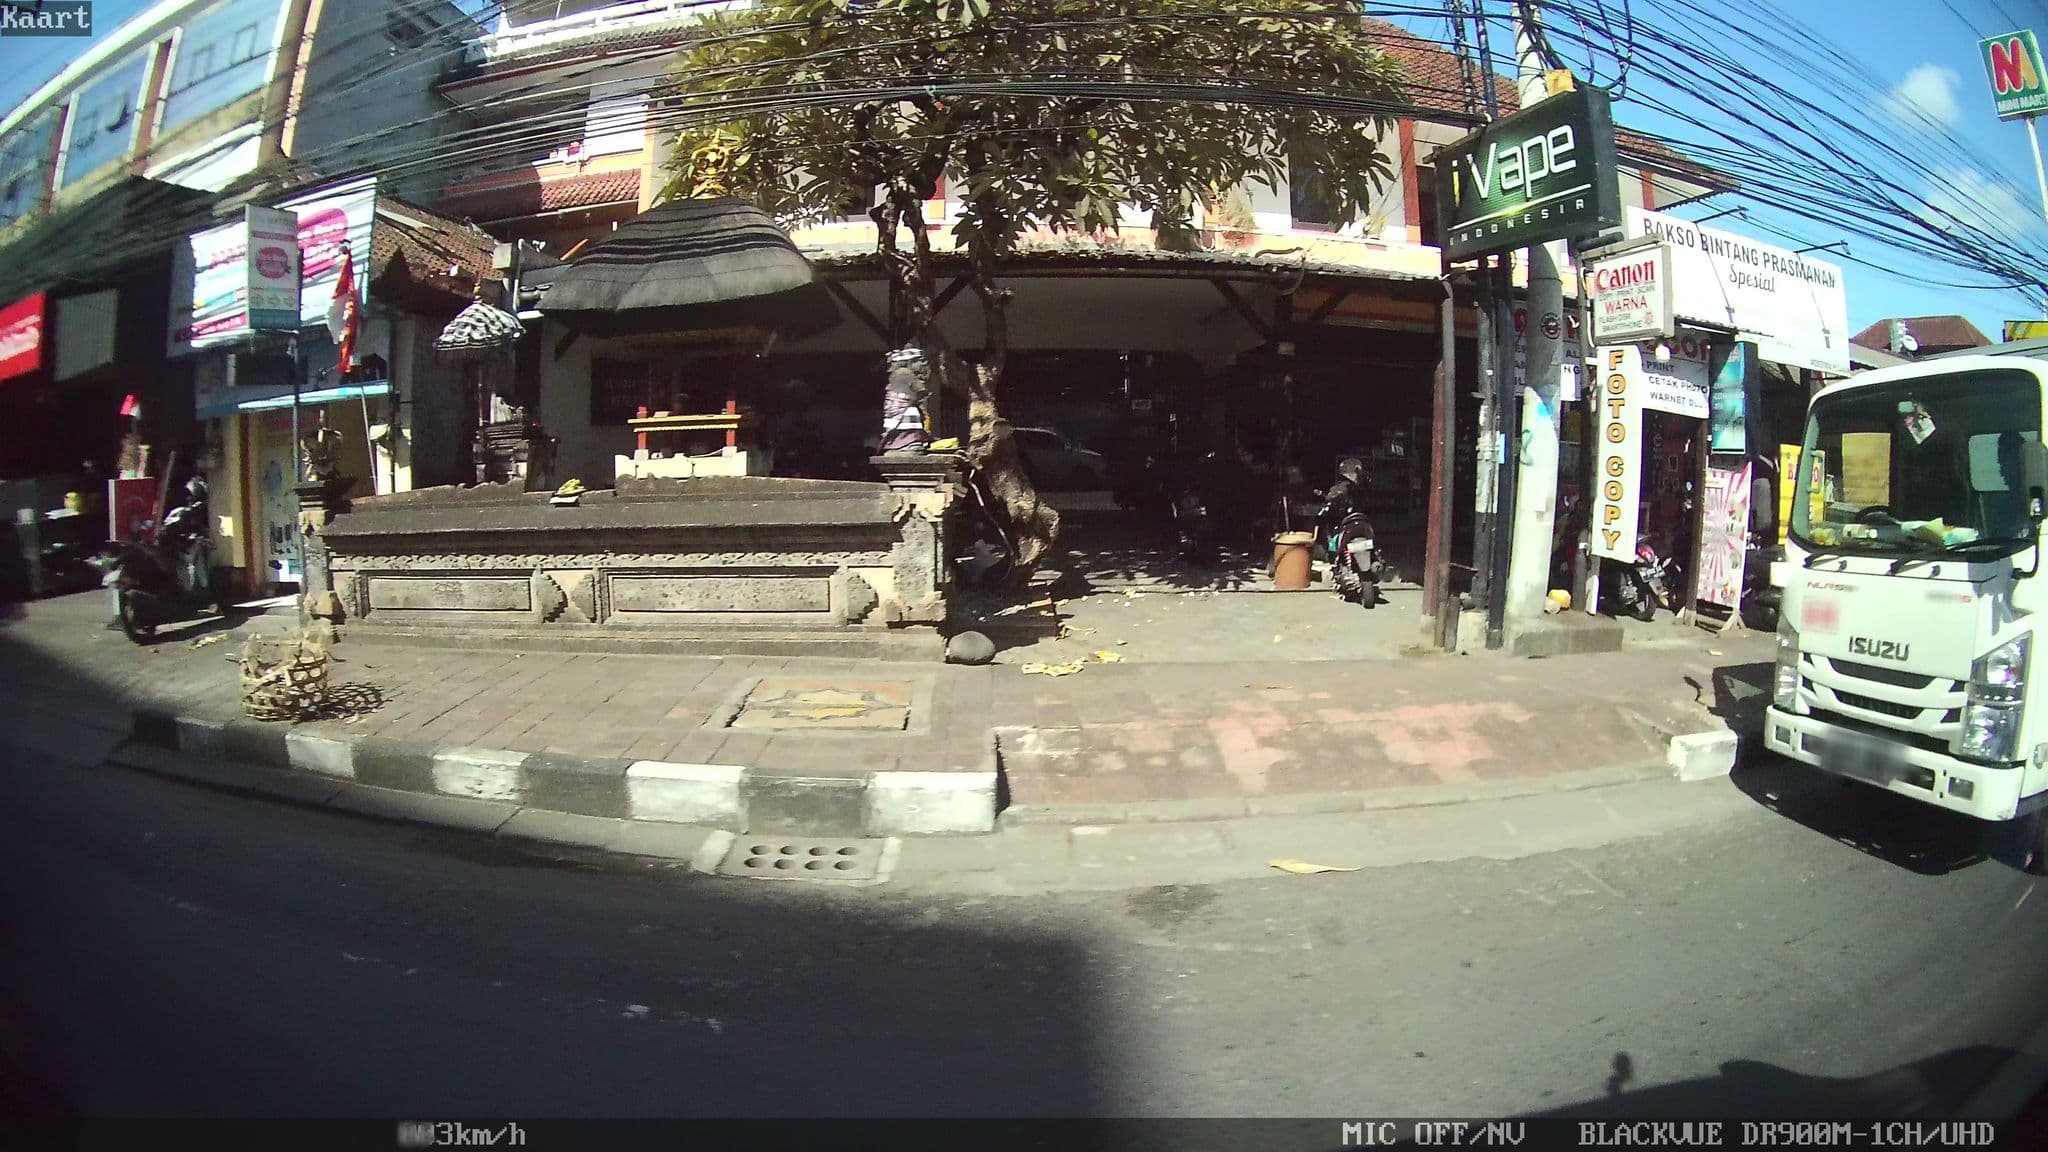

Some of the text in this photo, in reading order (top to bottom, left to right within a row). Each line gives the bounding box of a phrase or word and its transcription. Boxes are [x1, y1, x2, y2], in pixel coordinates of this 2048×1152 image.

[1997, 93, 2047, 113] MINI MART
[1643, 217, 1836, 289] BAKSO BINTANG PRASMANAN
[1595, 259, 1656, 293] Canon
[1728, 264, 1776, 294] Spesial
[1604, 294, 1648, 315] WARNA
[1645, 360, 1676, 374] PRINT
[1648, 375, 1708, 394] CETAK PHOTO
[1649, 391, 1687, 406] WARNET
[1601, 349, 1627, 551] FOTO COPY
[1848, 635, 1911, 662] ISUZU
